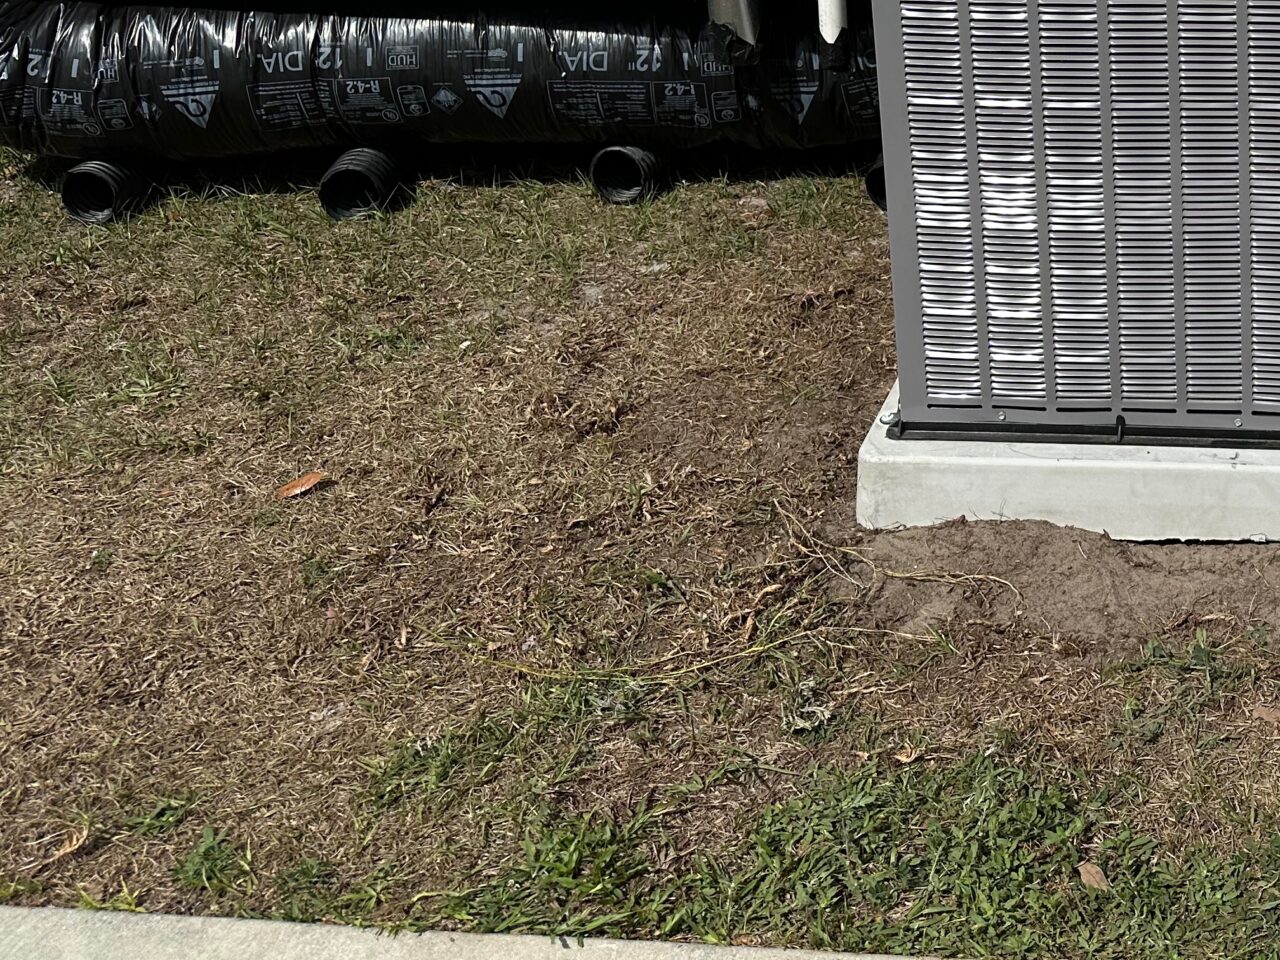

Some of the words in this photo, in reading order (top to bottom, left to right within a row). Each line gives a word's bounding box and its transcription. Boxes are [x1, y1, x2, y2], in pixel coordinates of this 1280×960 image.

[256, 50, 304, 74] DIA.
[388, 54, 416, 66] HUD
[558, 50, 608, 71] DIA.
[97, 68, 116, 80] HU
[345, 80, 381, 94] R-4.2
[51, 90, 83, 106] R-4.2
